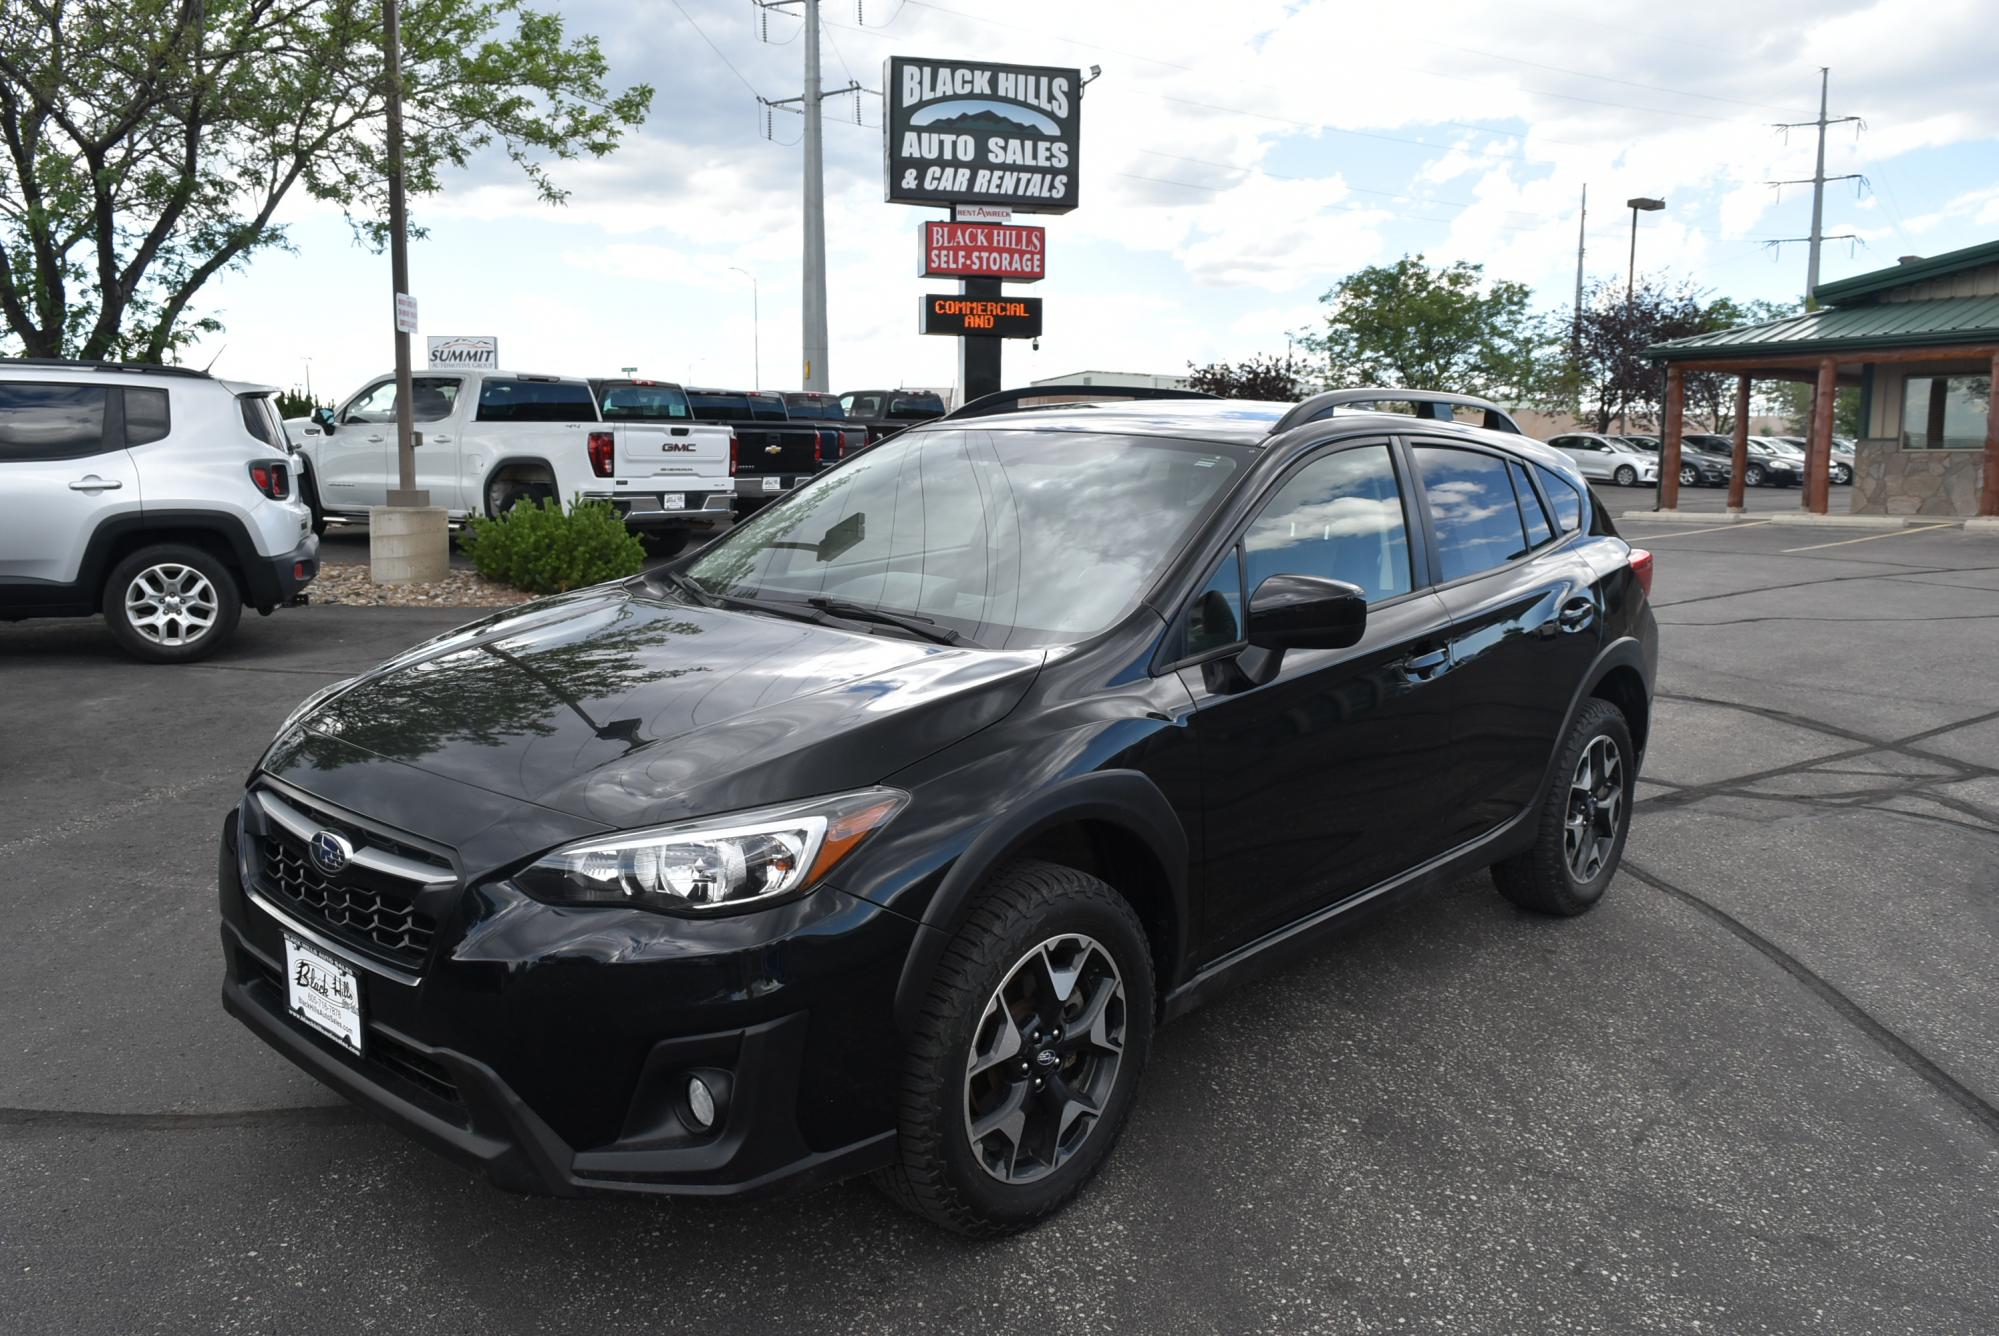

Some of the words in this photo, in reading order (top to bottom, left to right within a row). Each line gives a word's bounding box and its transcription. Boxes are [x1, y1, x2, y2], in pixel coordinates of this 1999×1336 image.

[902, 64, 992, 108] BLACK
[998, 72, 1069, 118] HILLS
[901, 131, 975, 161] AUTO
[988, 136, 1069, 168] SALES
[901, 168, 918, 189] &
[924, 166, 971, 192] CAR
[973, 169, 1067, 198] RENTALS
[932, 226, 989, 247] BLACK
[993, 229, 1041, 252] HILLS
[930, 249, 1041, 272] SELF-STORAGE
[935, 300, 1030, 316] COMMERCIAL
[964, 314, 994, 328] AND
[429, 349, 494, 362] SUMMIT
[661, 443, 696, 452] GMC
[293, 960, 329, 998] Black
[331, 974, 354, 1001] Hills
